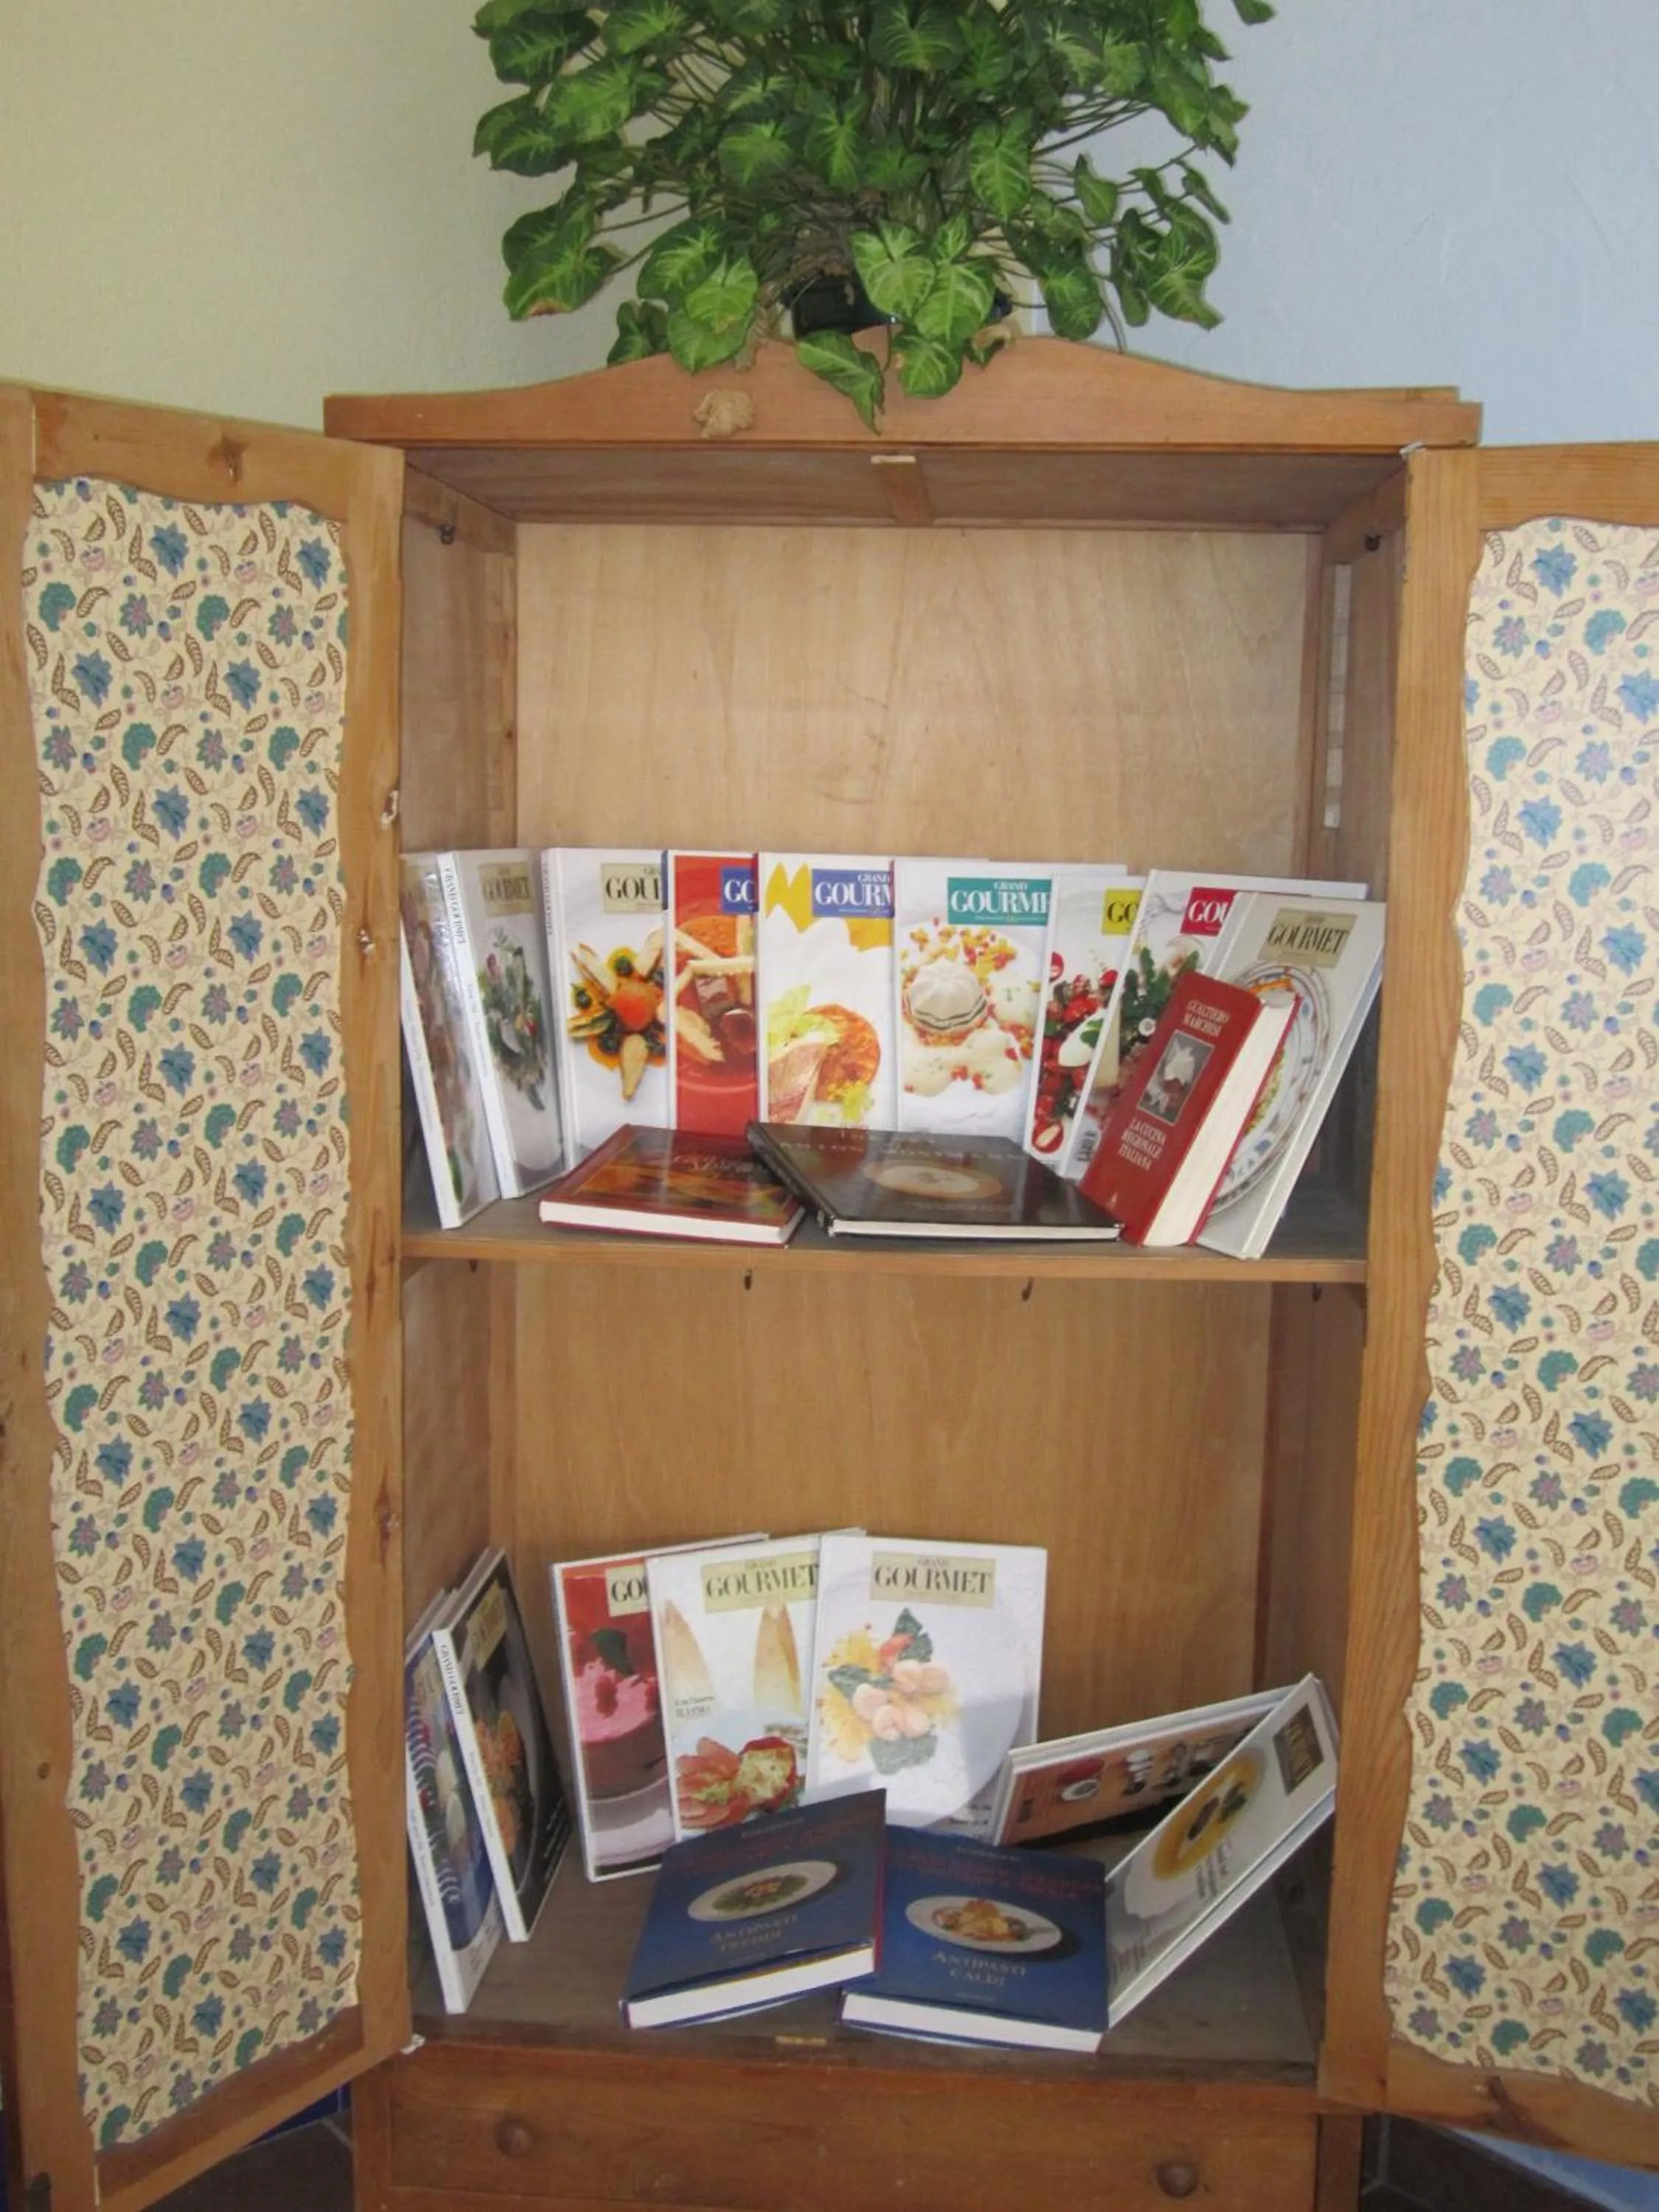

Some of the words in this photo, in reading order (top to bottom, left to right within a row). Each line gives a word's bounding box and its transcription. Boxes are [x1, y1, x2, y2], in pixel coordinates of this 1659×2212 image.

[1266, 922, 1349, 954] GOURMET
[706, 1563, 818, 1599] GOURMET
[874, 1566, 992, 1593] GOURMET
